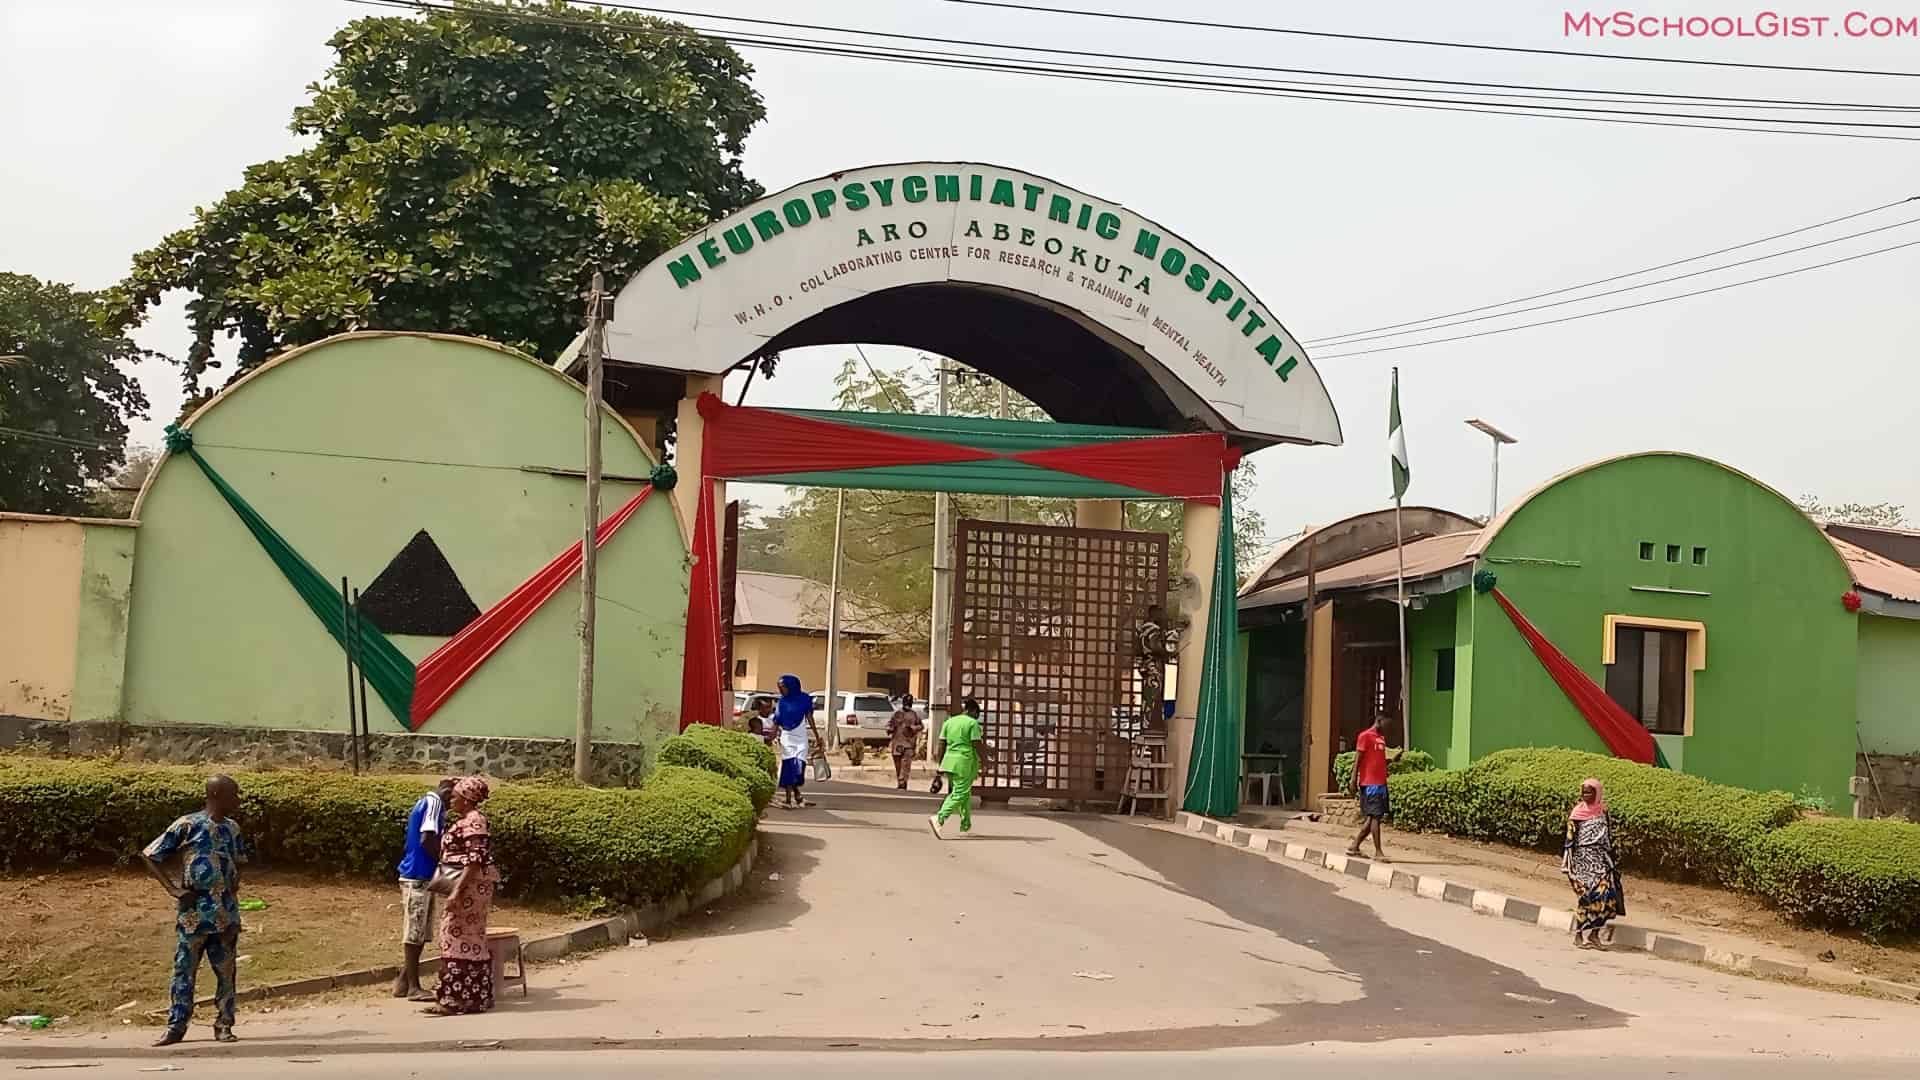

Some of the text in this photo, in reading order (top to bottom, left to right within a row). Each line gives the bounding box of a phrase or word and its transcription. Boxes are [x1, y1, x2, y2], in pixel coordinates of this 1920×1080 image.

[666, 174, 1298, 383] NEUROPSYCHIATRIC HOSPITAL
[734, 245, 1226, 388] W.H.O. COLLABORATING CENTRE FOR RESEARCH & TRAINING IN MENTAL HEALTH
[856, 220, 1151, 295] ARO ABEOKUTA
